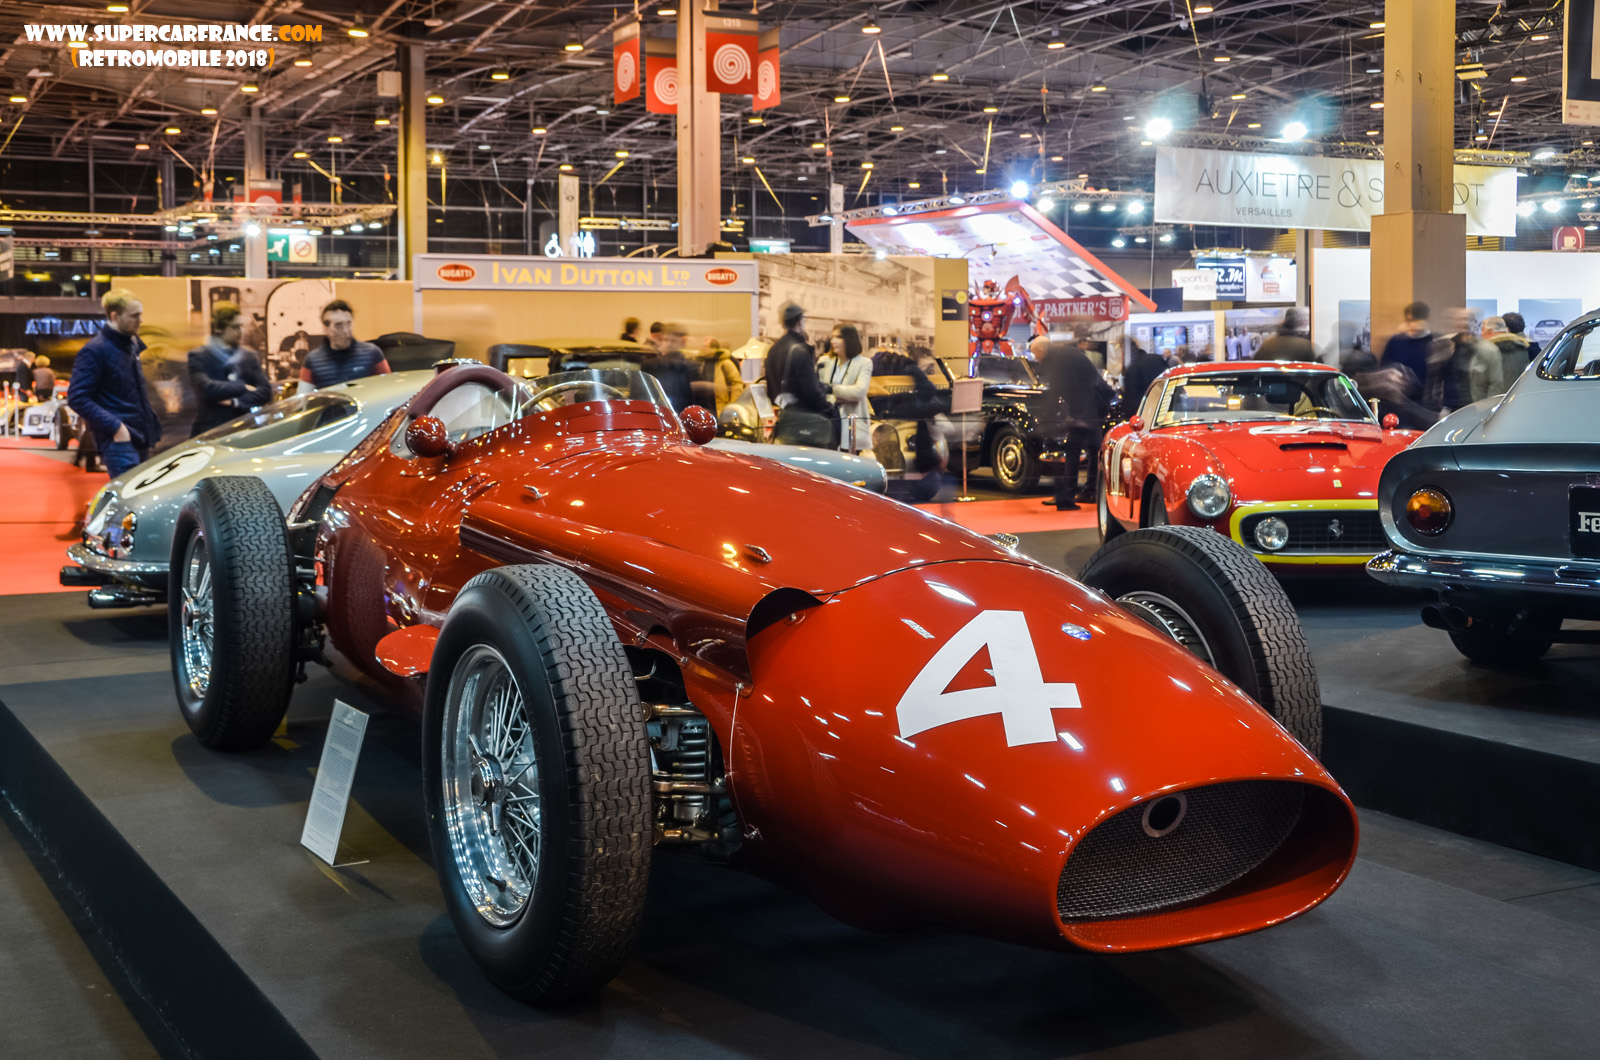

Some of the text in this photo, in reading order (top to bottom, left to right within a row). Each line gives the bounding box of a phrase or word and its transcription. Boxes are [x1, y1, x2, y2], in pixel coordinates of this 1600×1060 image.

[1195, 168, 1331, 200] AUXIETRE
[1337, 170, 1363, 208] &
[1235, 207, 1293, 218] VERSAILLES
[440, 269, 473, 278] BUGATTI
[707, 272, 736, 281] BUGATTI
[1044, 301, 1107, 317] PARTNER'S
[25, 319, 107, 335] ATLAN
[896, 610, 1082, 747] 4
